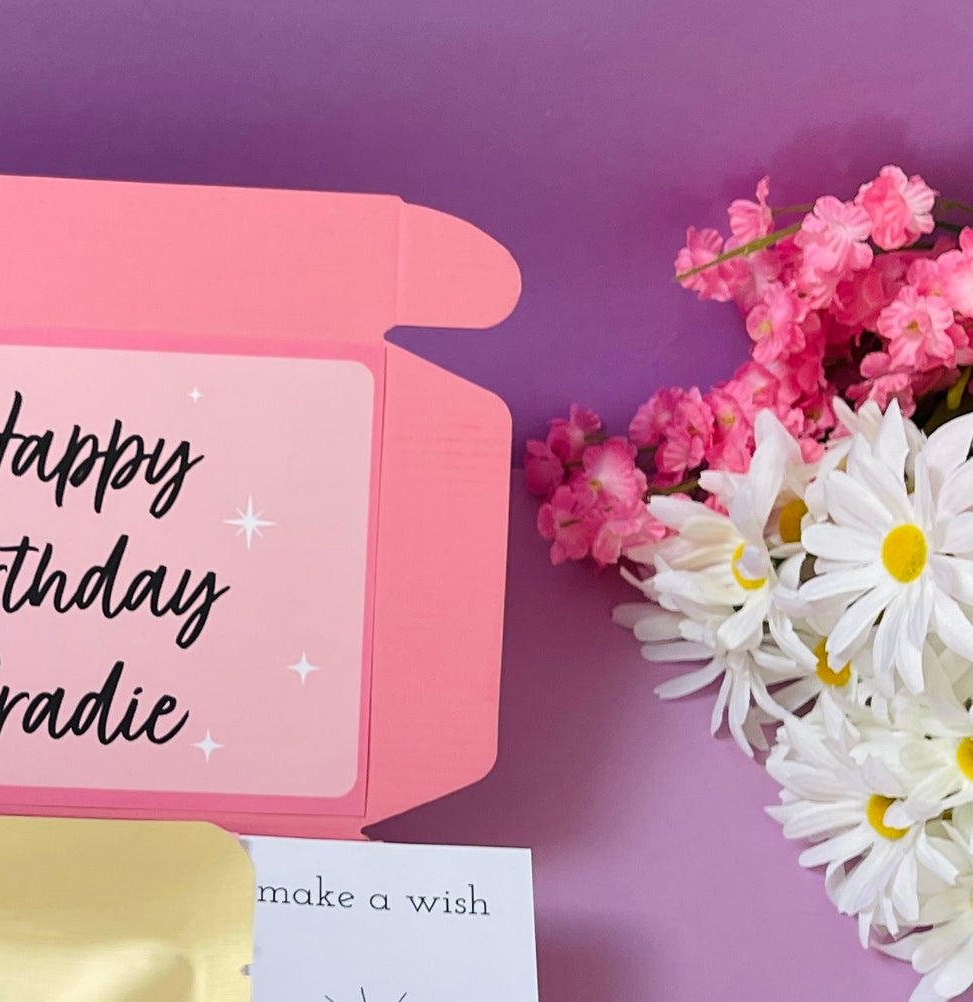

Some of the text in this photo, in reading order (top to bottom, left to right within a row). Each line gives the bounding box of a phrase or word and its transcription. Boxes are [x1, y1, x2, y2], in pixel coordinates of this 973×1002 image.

[257, 875, 490, 915] make a wish
